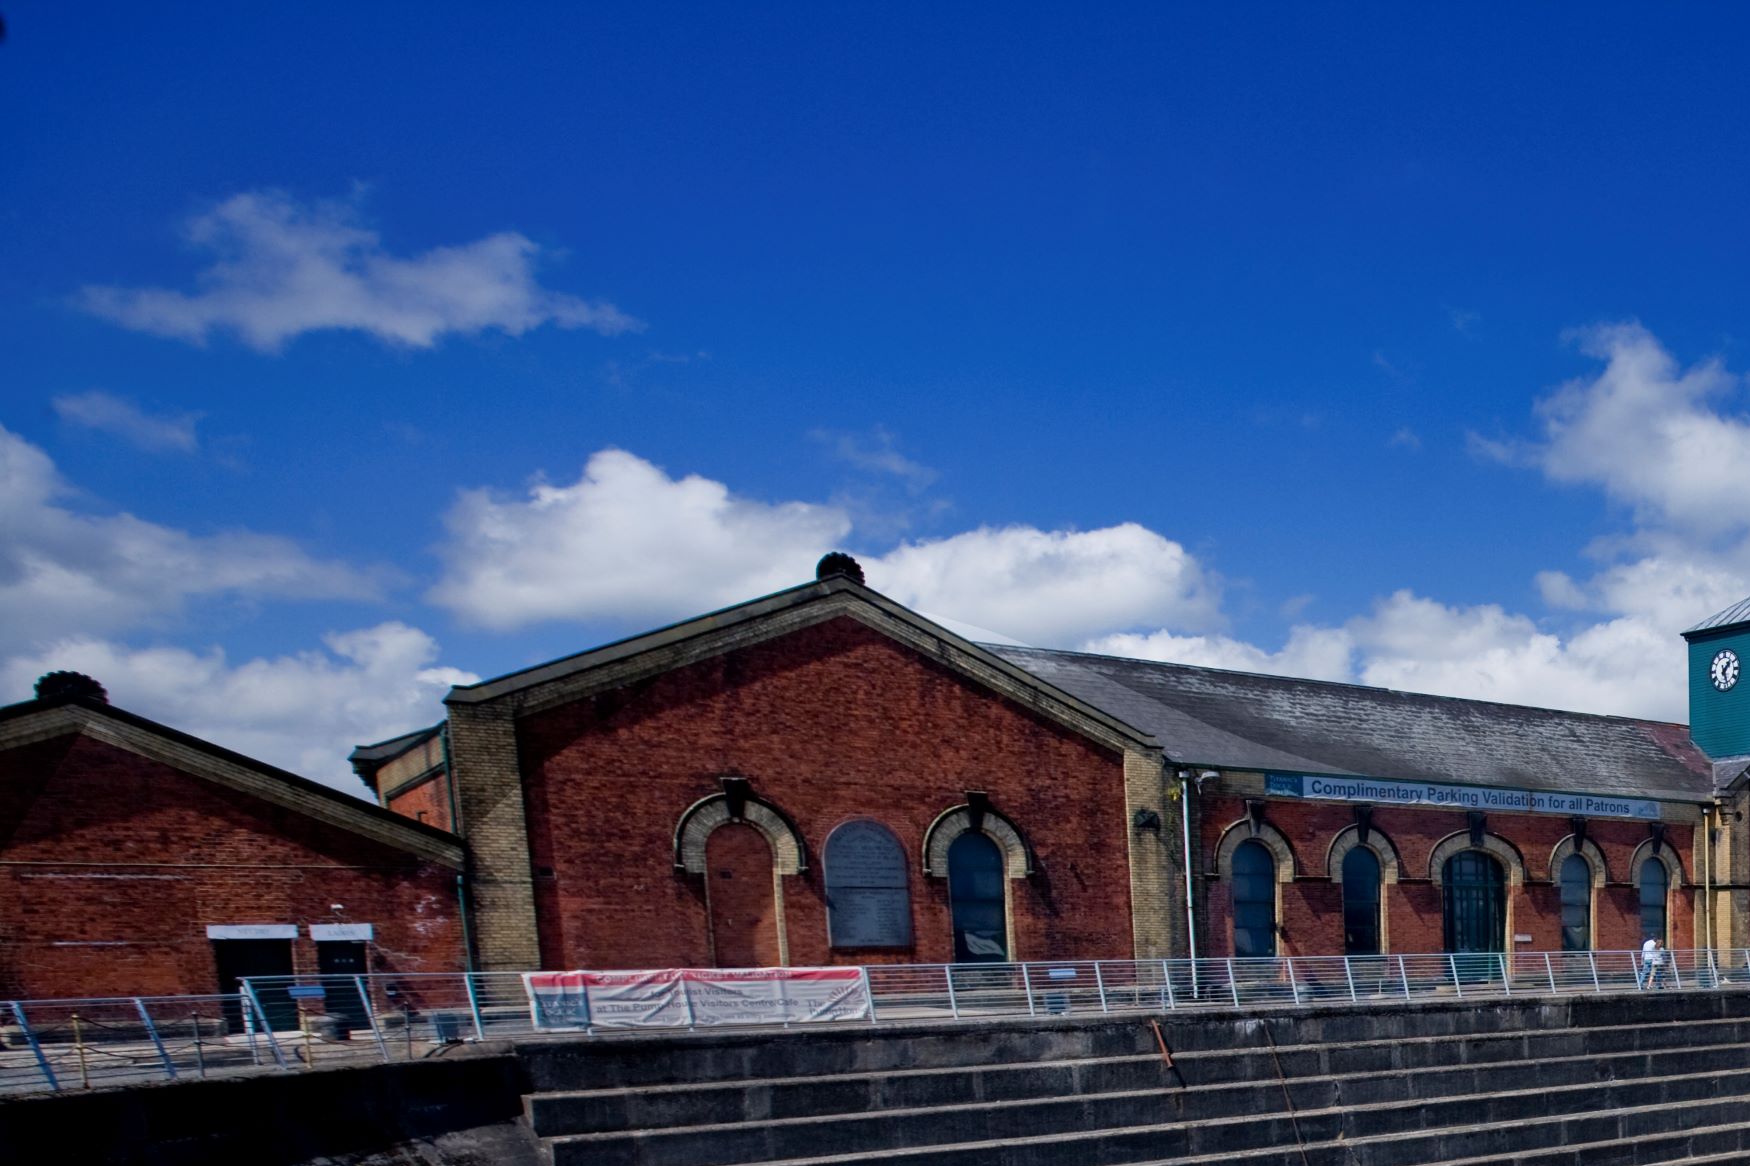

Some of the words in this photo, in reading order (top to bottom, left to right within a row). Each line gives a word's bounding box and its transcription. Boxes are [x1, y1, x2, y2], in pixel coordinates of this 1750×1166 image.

[1311, 780, 1422, 801] Complimentary
[1427, 787, 1478, 806] Parking
[1482, 791, 1545, 808] Validation
[1548, 795, 1566, 809] for
[1569, 798, 1583, 811] all
[1586, 800, 1630, 814] Patrons
[705, 988, 743, 997] Visitors
[597, 1005, 609, 1014] at
[610, 1004, 629, 1013] The
[701, 998, 739, 1008] Visitors
